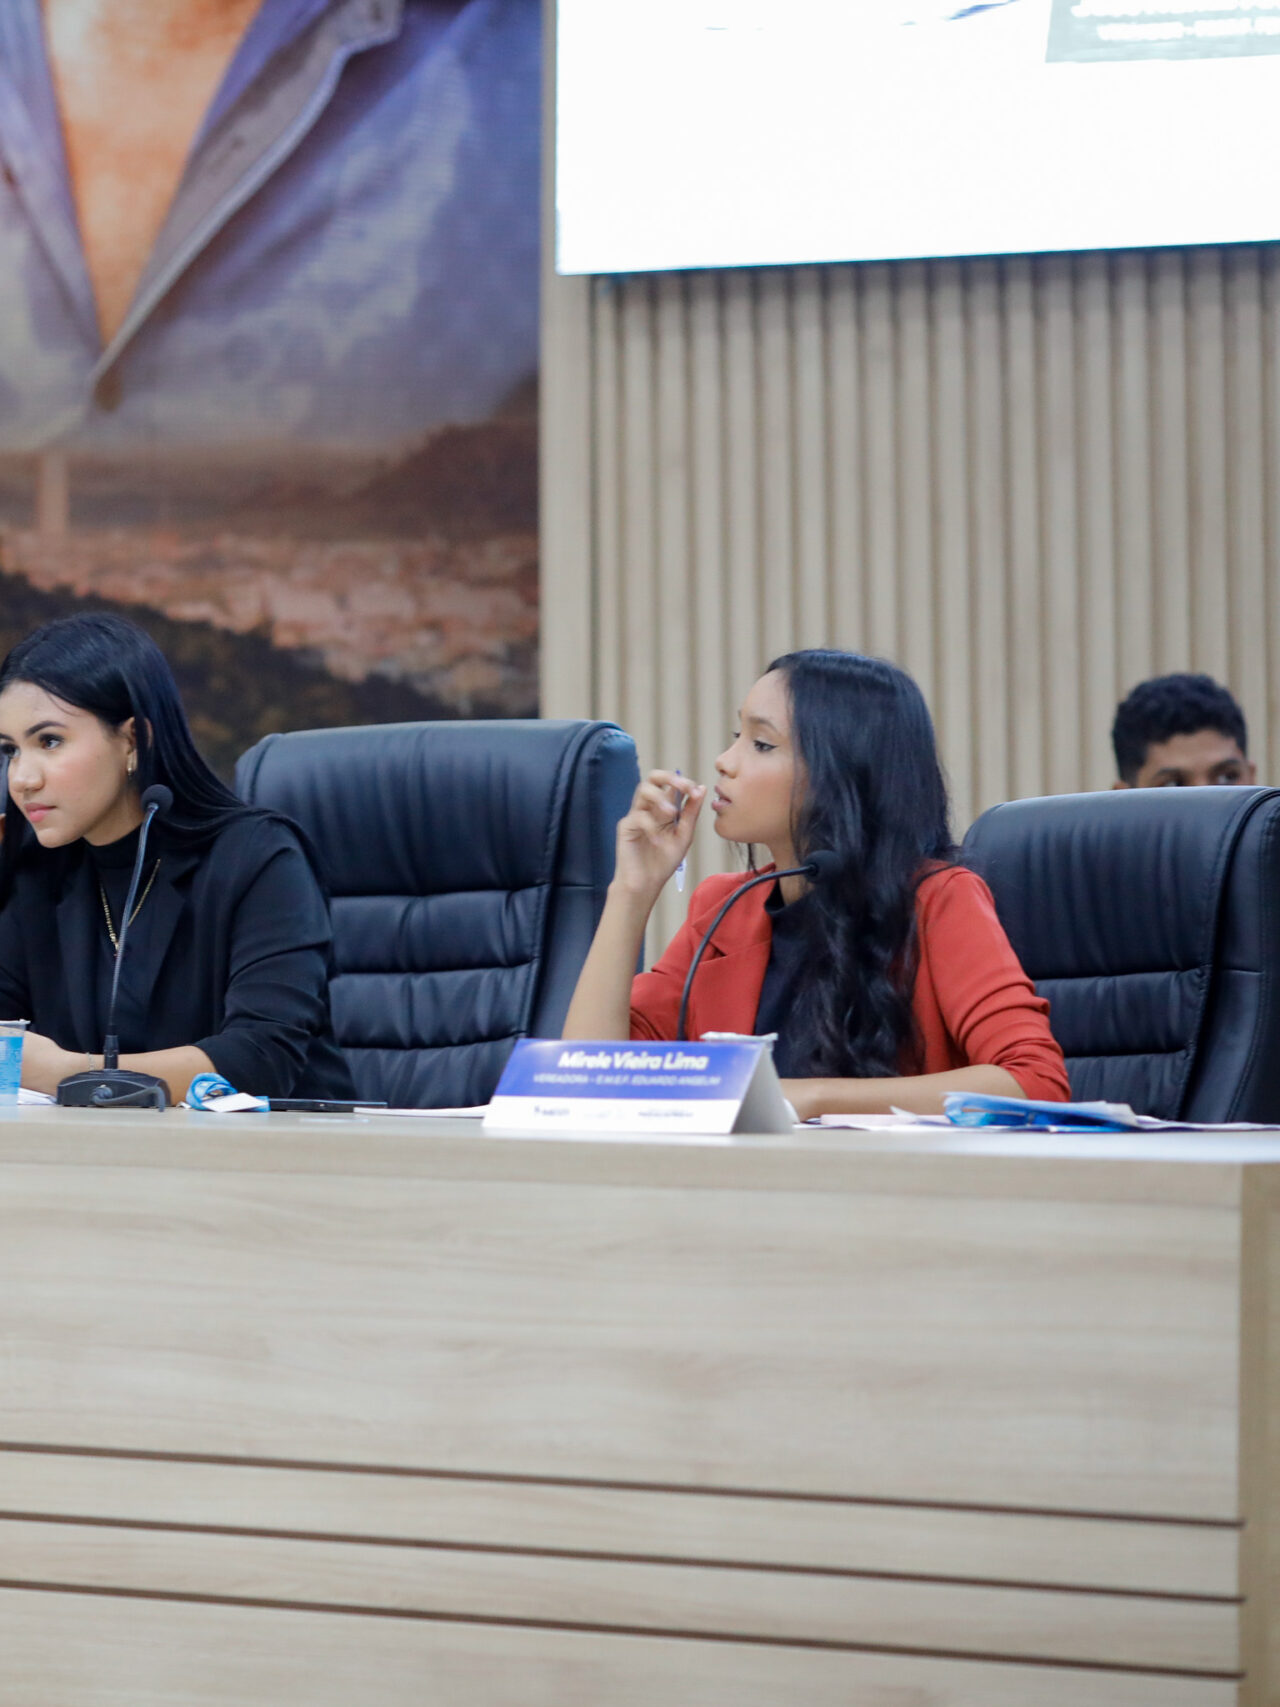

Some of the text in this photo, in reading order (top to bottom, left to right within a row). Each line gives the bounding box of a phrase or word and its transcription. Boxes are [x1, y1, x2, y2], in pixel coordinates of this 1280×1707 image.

[558, 1051, 710, 1071] Mirele Vieira Lima
[533, 1072, 589, 1084] VEREADORA
